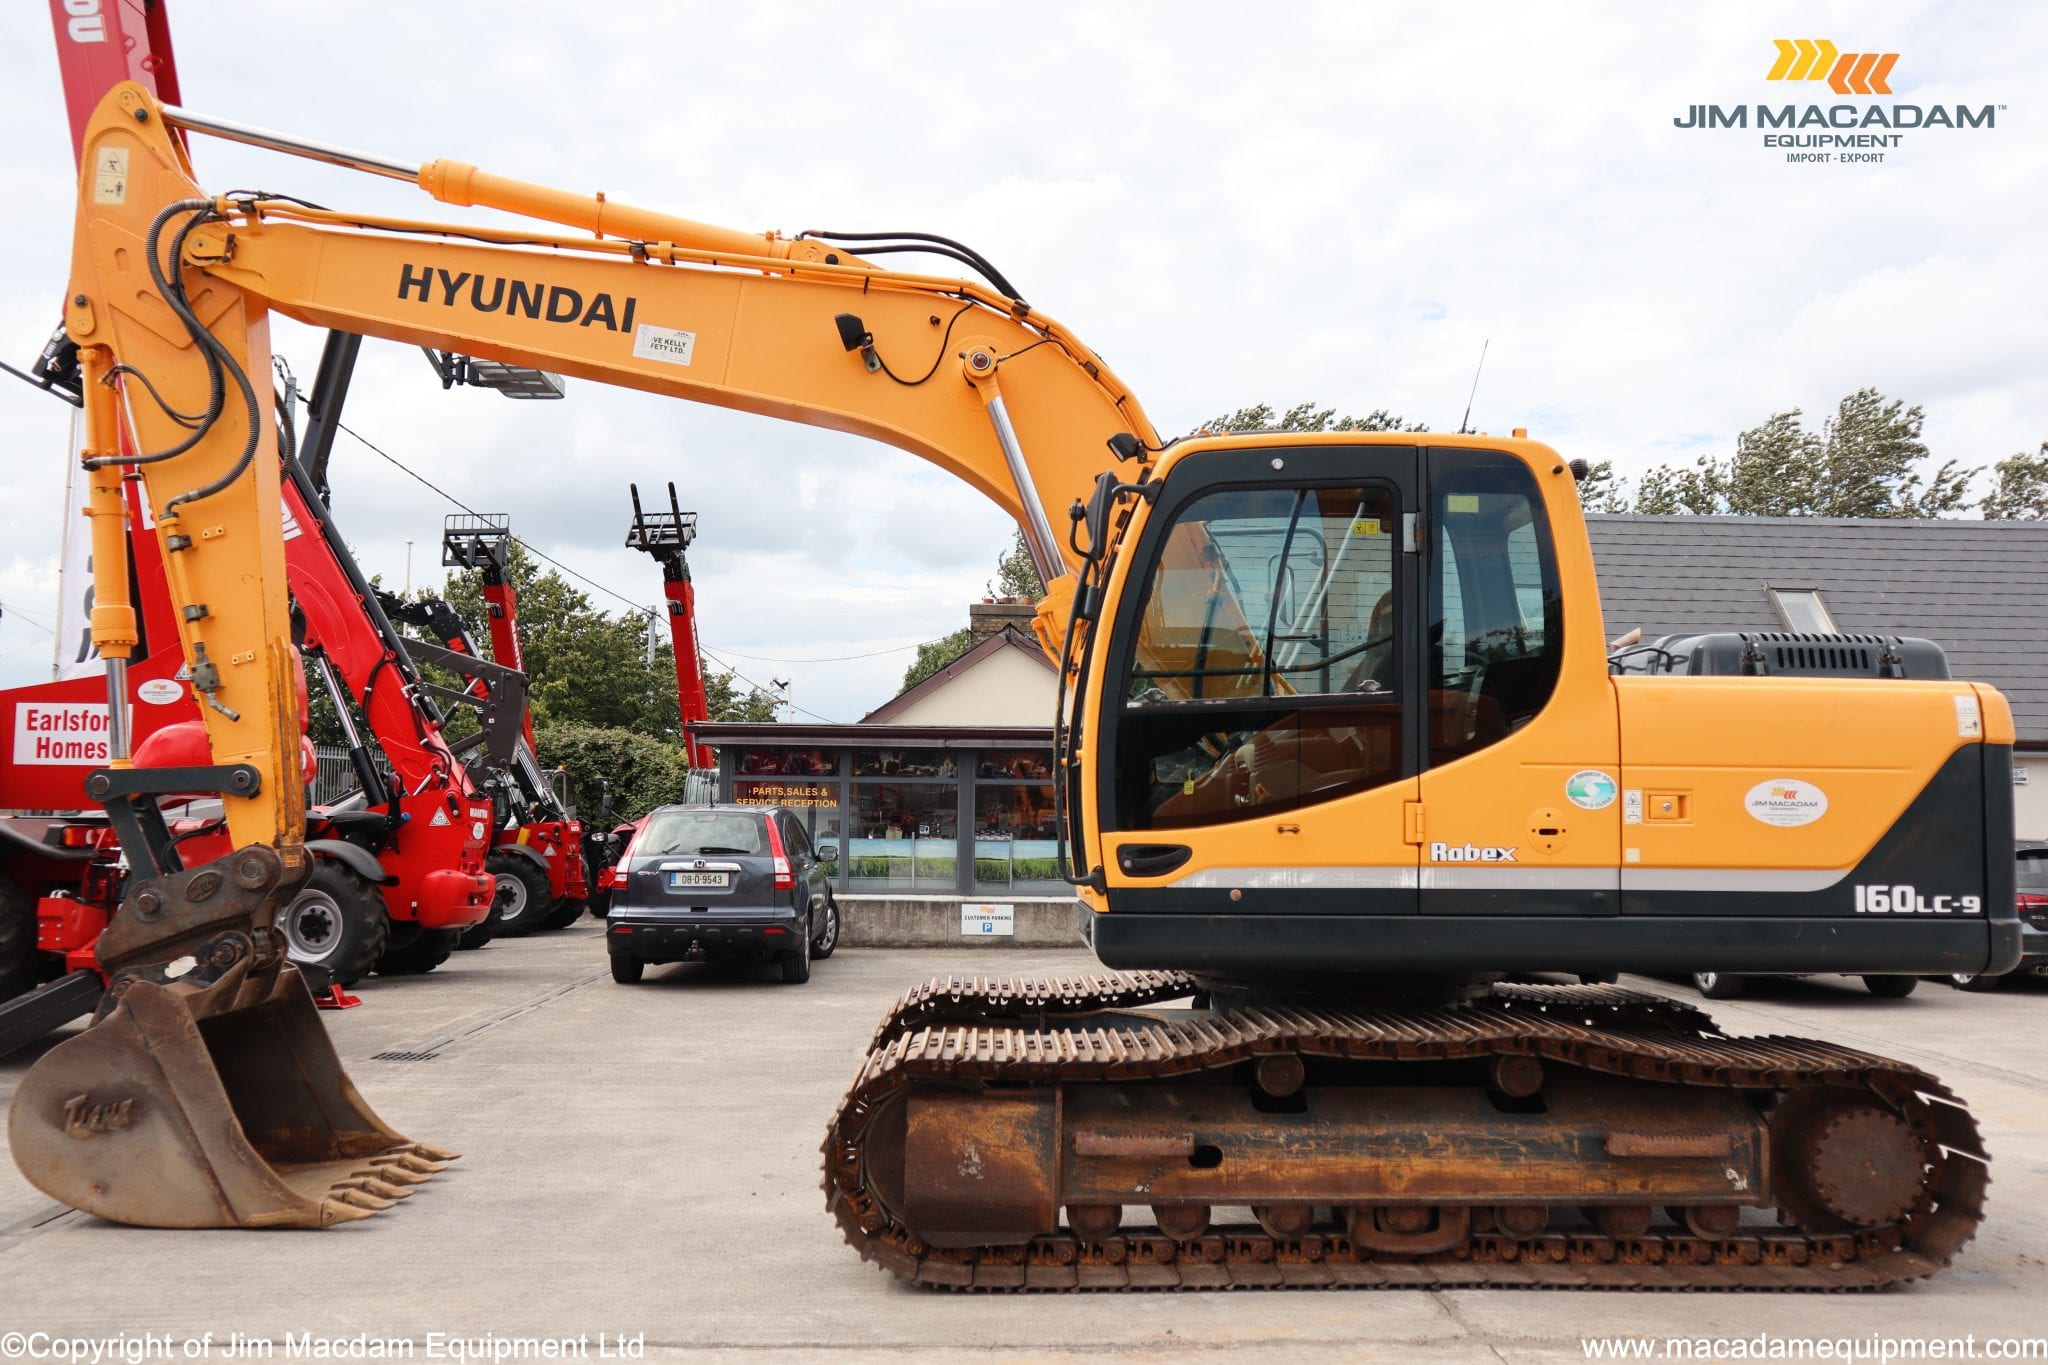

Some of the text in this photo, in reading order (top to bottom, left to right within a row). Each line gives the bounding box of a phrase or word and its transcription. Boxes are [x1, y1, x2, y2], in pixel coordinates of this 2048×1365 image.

[398, 264, 637, 333] HYUNDAI
[664, 339, 687, 348] KELLY
[27, 709, 109, 731] Earlsfor
[36, 737, 107, 760] Homes
[820, 788, 828, 796] &
[736, 798, 837, 808] SERVICE RECEPTION
[1430, 841, 1519, 862] Robex
[1854, 885, 1981, 913] 160LC-9
